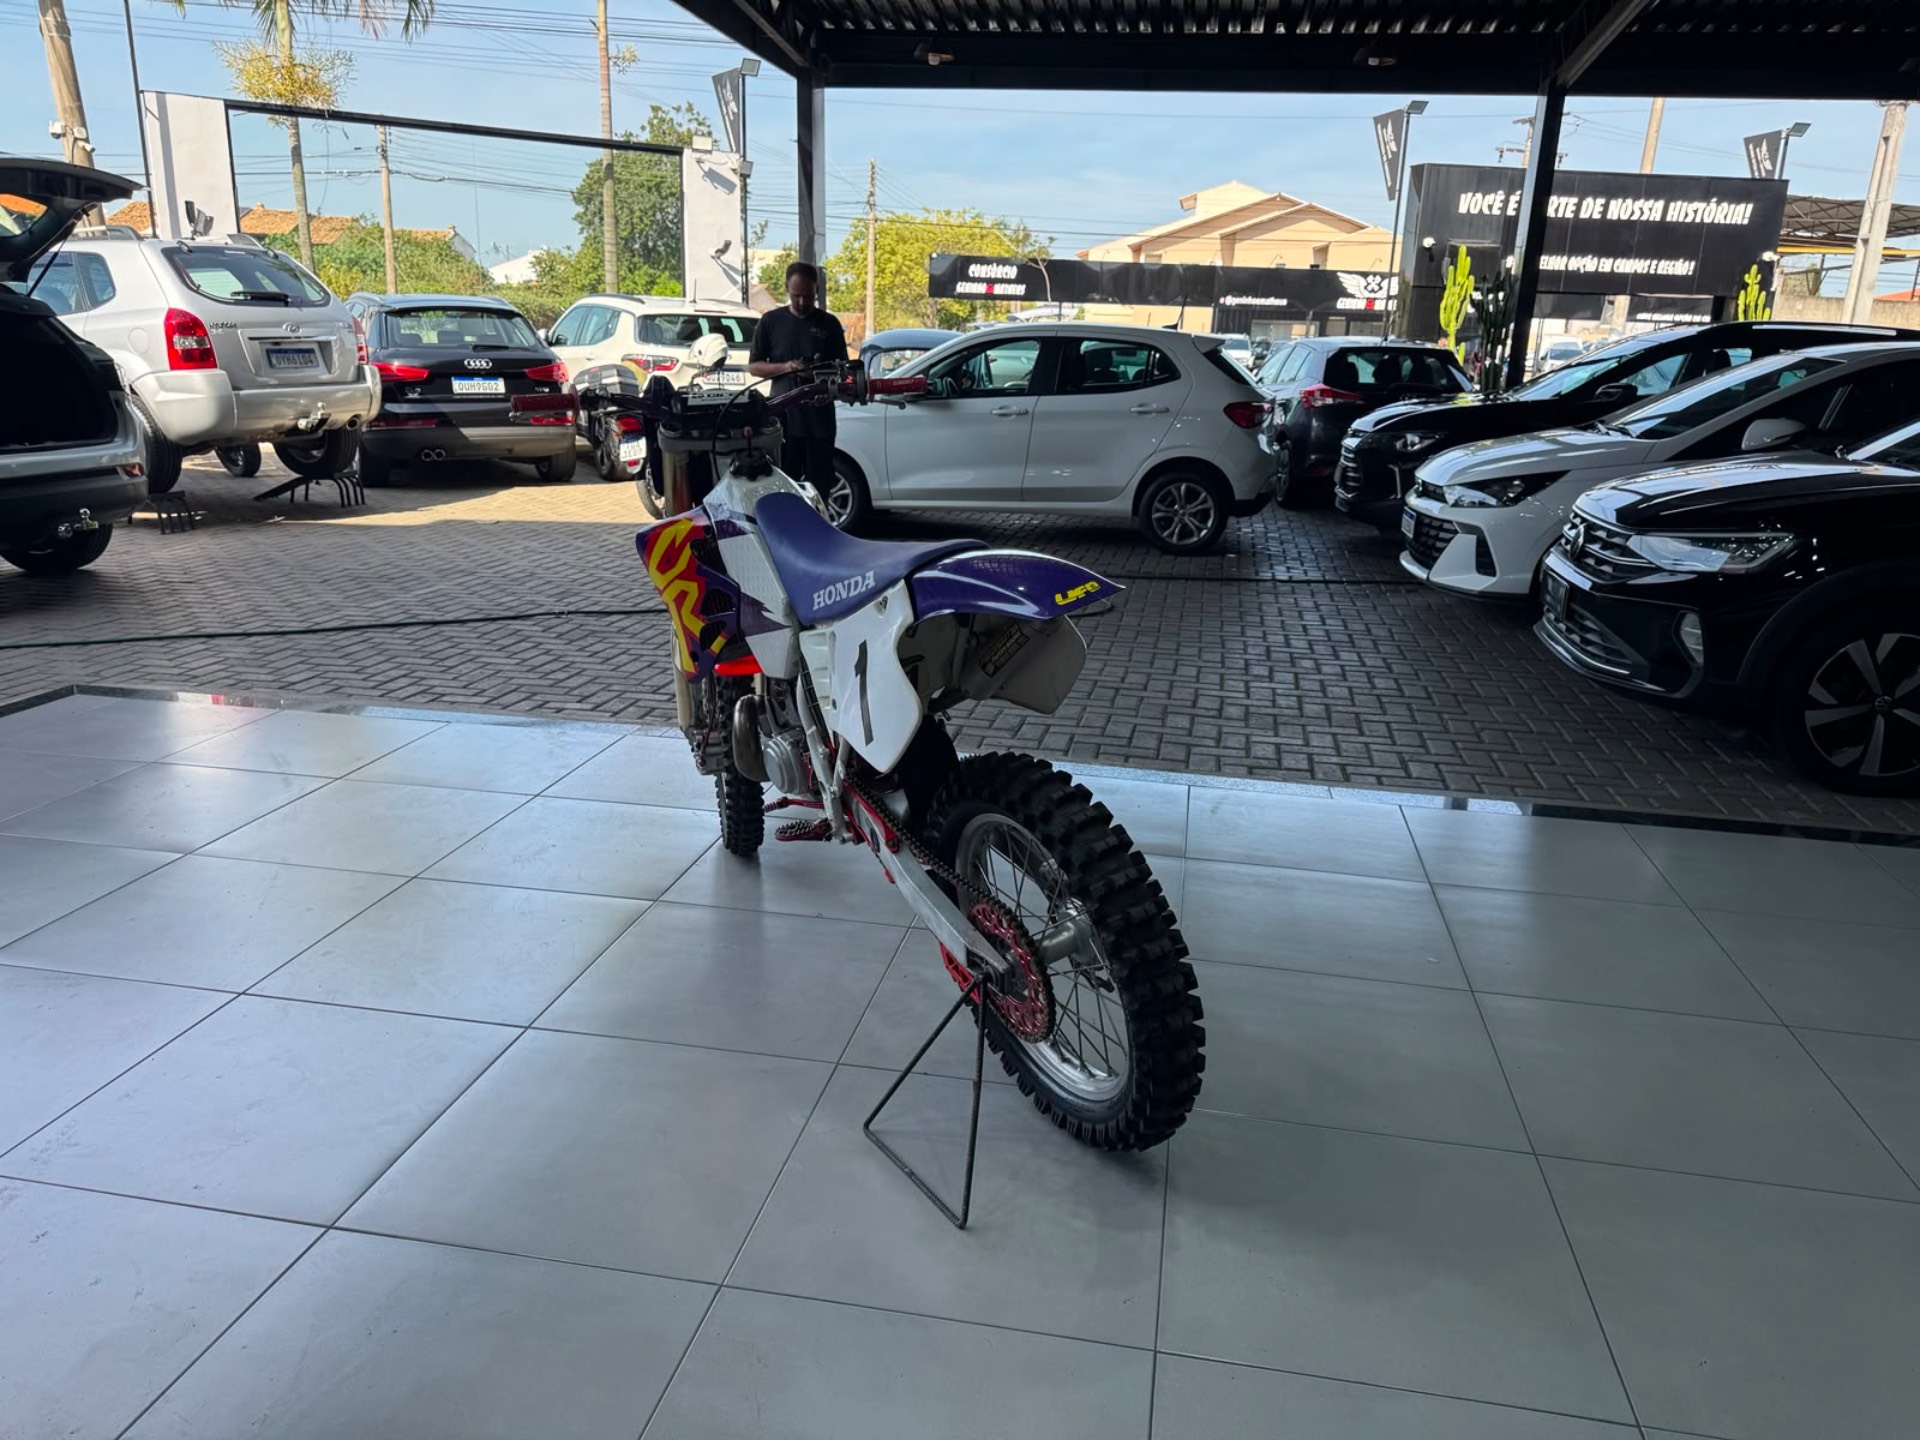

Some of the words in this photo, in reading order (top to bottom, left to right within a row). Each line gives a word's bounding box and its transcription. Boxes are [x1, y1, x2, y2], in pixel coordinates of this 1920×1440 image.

[1458, 190, 1505, 215] VOCÊ
[1506, 190, 1521, 216] É
[1546, 195, 1578, 218] RTE
[1579, 196, 1606, 219] DE
[1606, 198, 1664, 221] NOSSA
[1666, 198, 1753, 225] HISTÓRIA!
[1539, 255, 1568, 271] ELHOR
[1567, 255, 1598, 273] OPÇÃO
[1598, 258, 1613, 273] EM
[1613, 258, 1649, 274] CAMPOS
[1650, 260, 1657, 274] E
[1656, 259, 1696, 276] REGIÃO!
[813, 570, 876, 612] HONDA
[1055, 580, 1101, 605] UFO
[853, 638, 874, 747] 1
